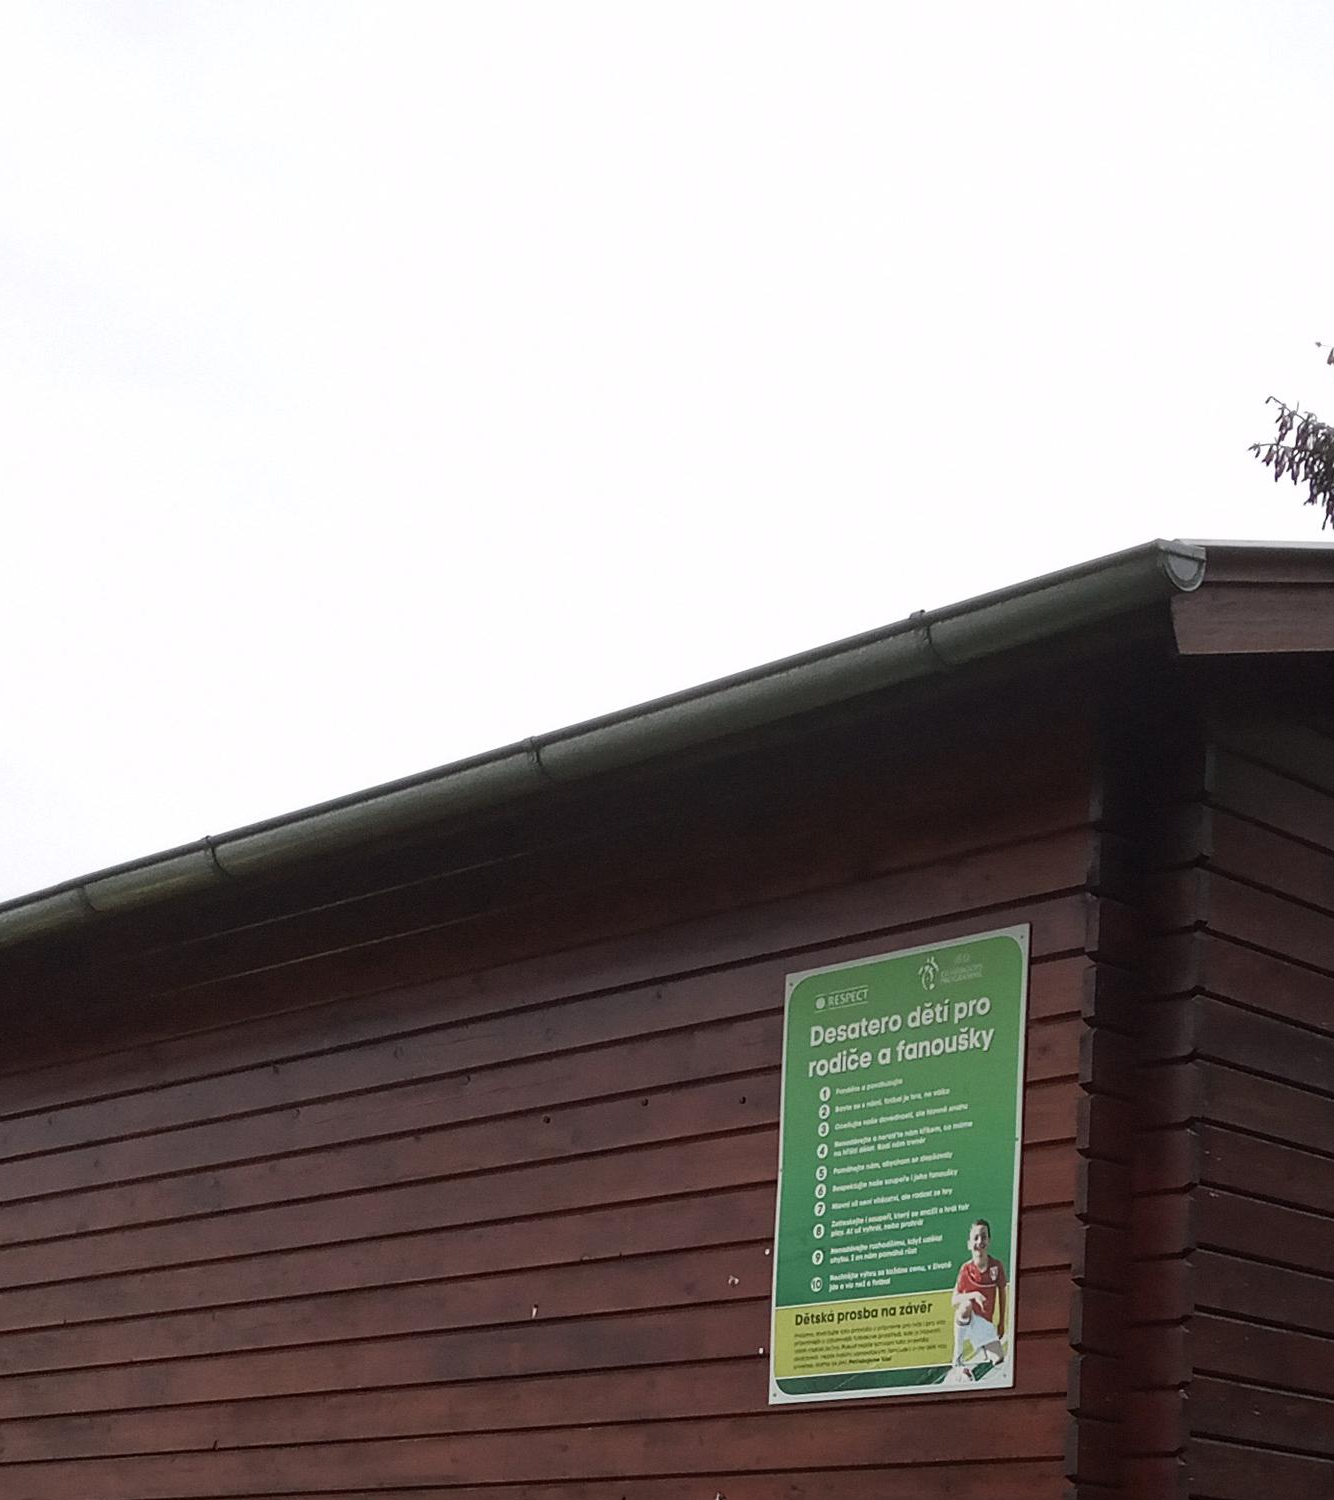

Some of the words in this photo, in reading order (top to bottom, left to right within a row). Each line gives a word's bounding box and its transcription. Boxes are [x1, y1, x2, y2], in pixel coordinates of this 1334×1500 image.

[828, 988, 869, 1006] RESPECT
[810, 1013, 902, 1047] Desatero
[907, 1001, 949, 1029] dětí
[954, 997, 991, 1024] pro
[808, 1048, 871, 1078] rodiče
[877, 1048, 891, 1065] a
[895, 1026, 995, 1062] fanoušky
[795, 1310, 835, 1326] Dětská
[837, 1305, 879, 1323] prosba
[882, 1307, 896, 1317] na
[899, 1301, 933, 1316] závěr
